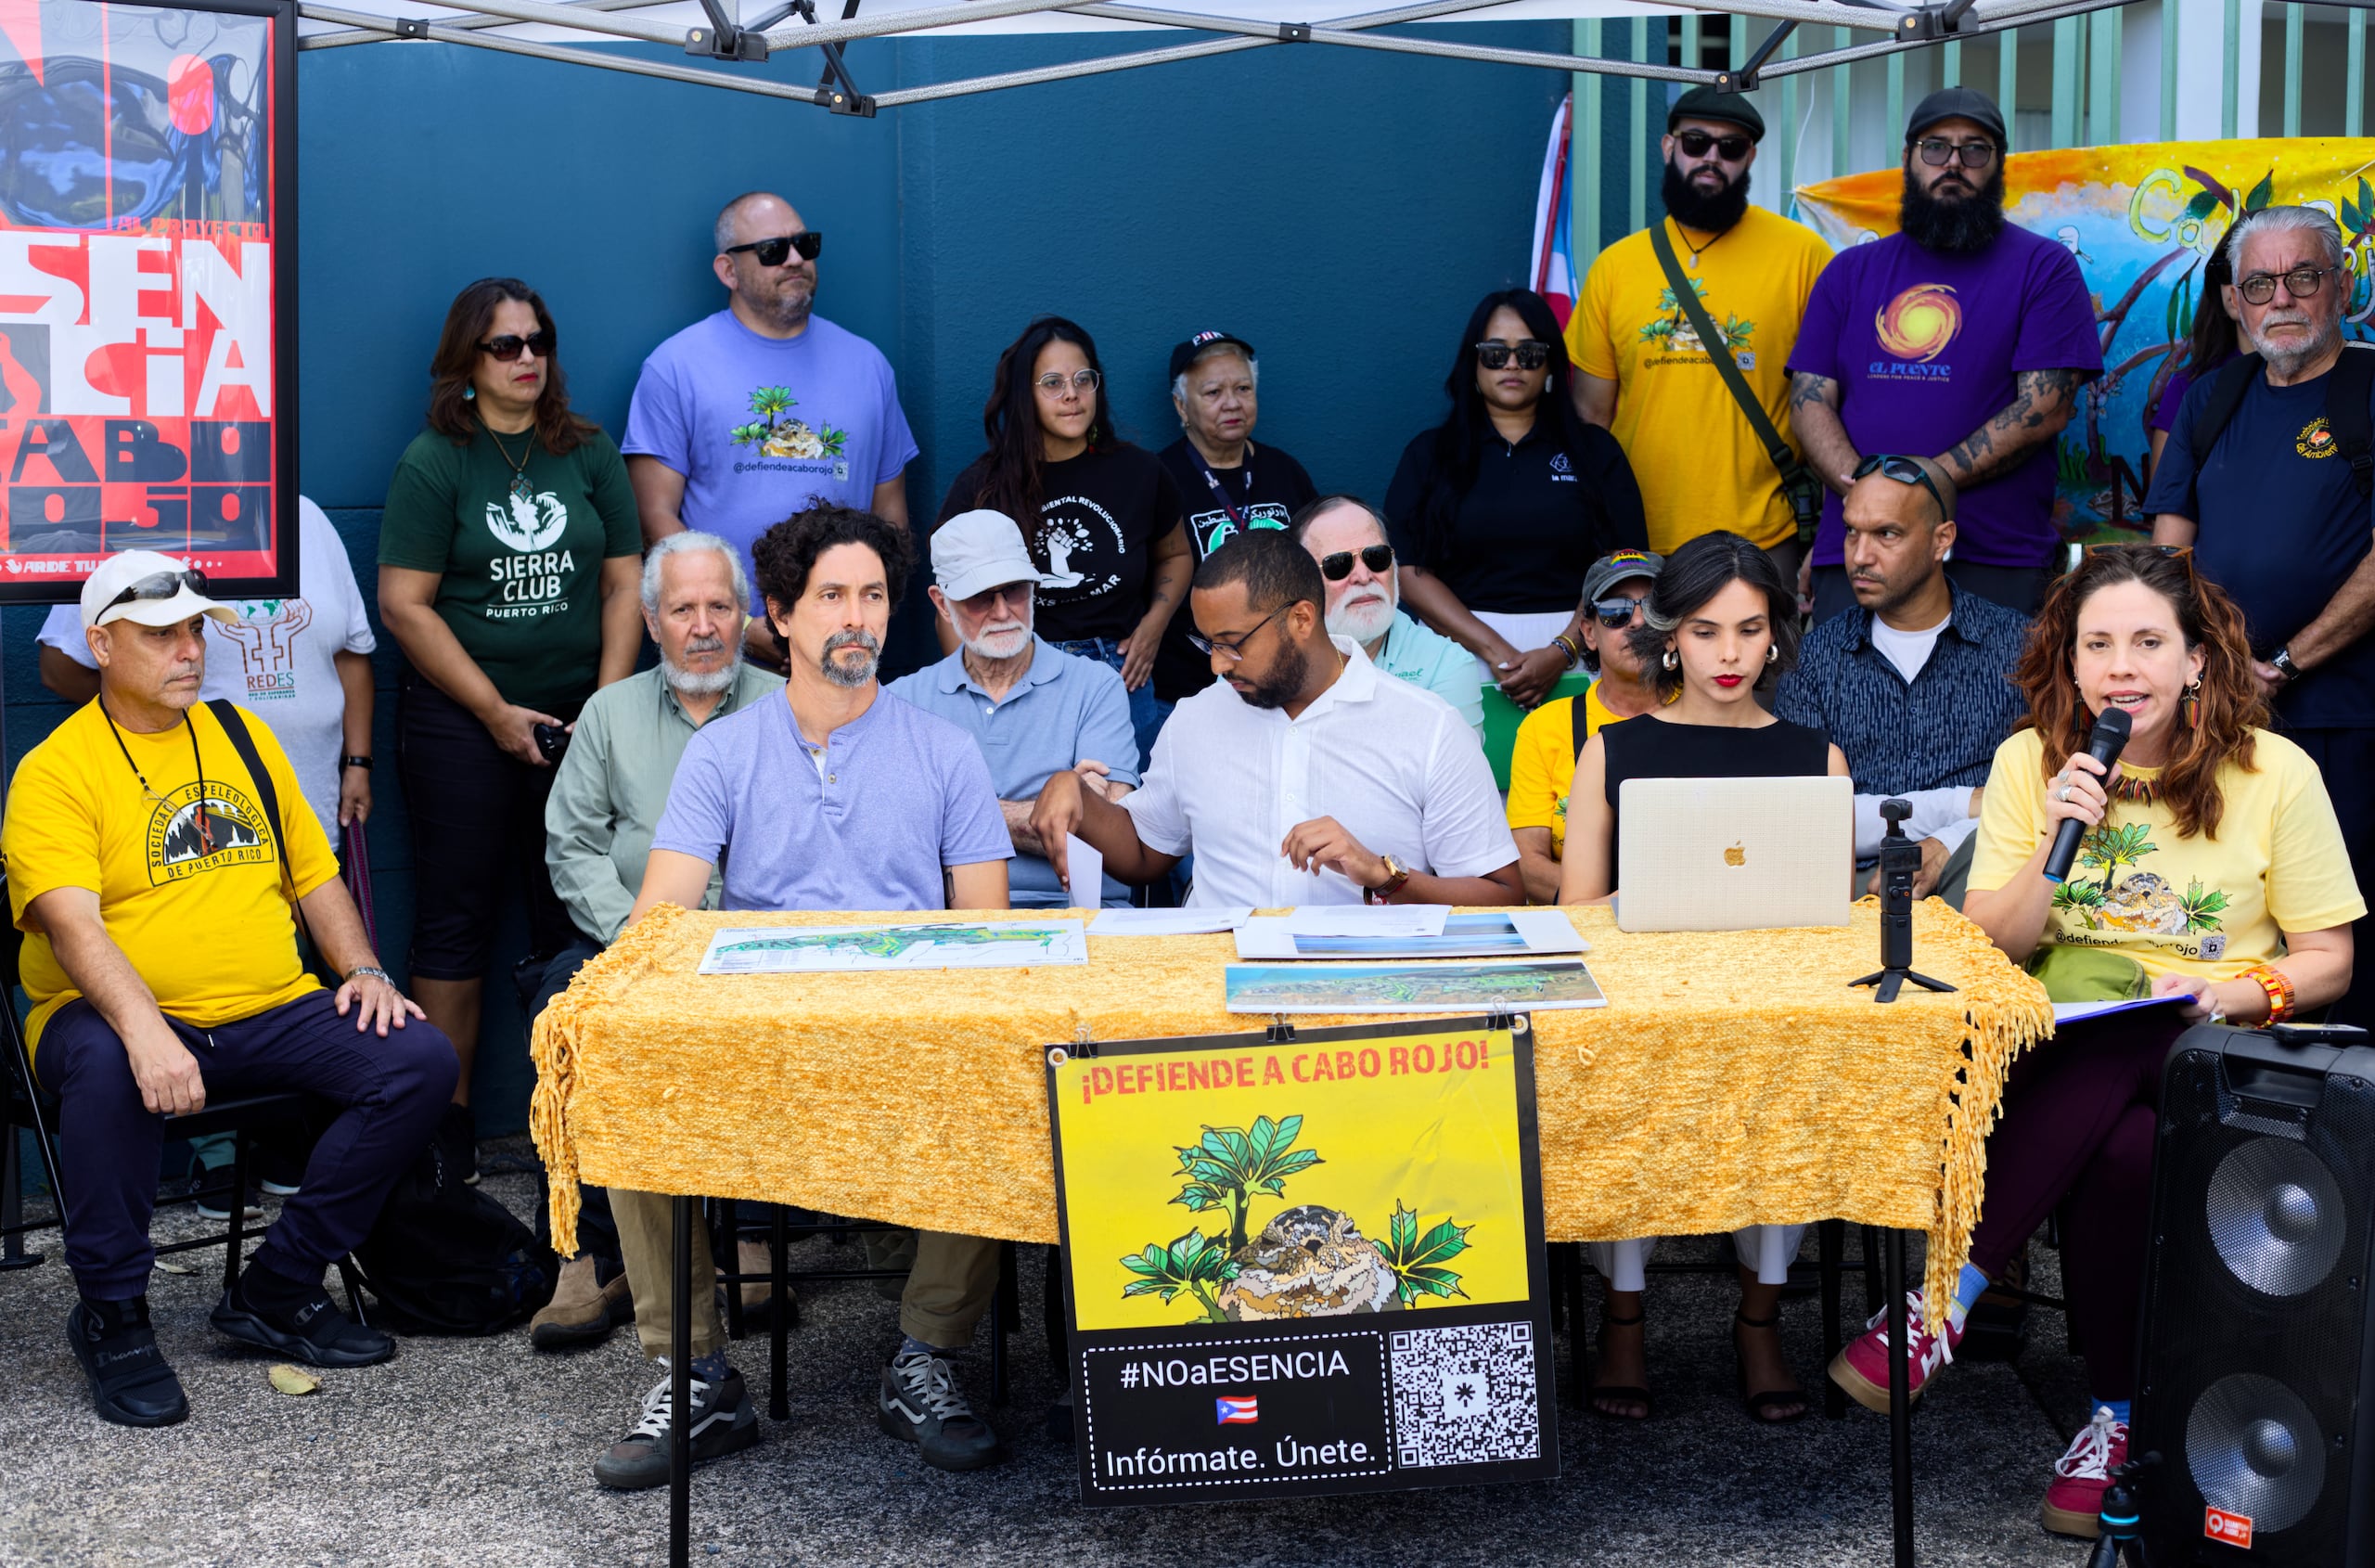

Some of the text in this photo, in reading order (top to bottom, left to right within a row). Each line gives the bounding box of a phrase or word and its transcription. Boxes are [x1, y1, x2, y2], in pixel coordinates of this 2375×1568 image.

[0, 419, 271, 482] ABO
[733, 461, 833, 476] @defiendeacaborojo
[0, 485, 271, 553] OJO
[1078, 496, 1126, 555] REVOLUCIONARIO
[23, 559, 71, 573] ARDE
[489, 549, 575, 582] SIERRA
[503, 574, 561, 602] CLUB
[1089, 574, 1122, 597] MAR
[486, 601, 569, 619] PUERTO RICO
[246, 672, 295, 689] REDES
[167, 847, 263, 879] DE PUERTO RICO
[1262, 1053, 1286, 1086] A
[1291, 1047, 1382, 1084] CABO
[1388, 1039, 1490, 1076] ROJO!
[1120, 1349, 1351, 1390] #NOaESENCIA
[1106, 1434, 1377, 1478] Infórmate. Únete.
